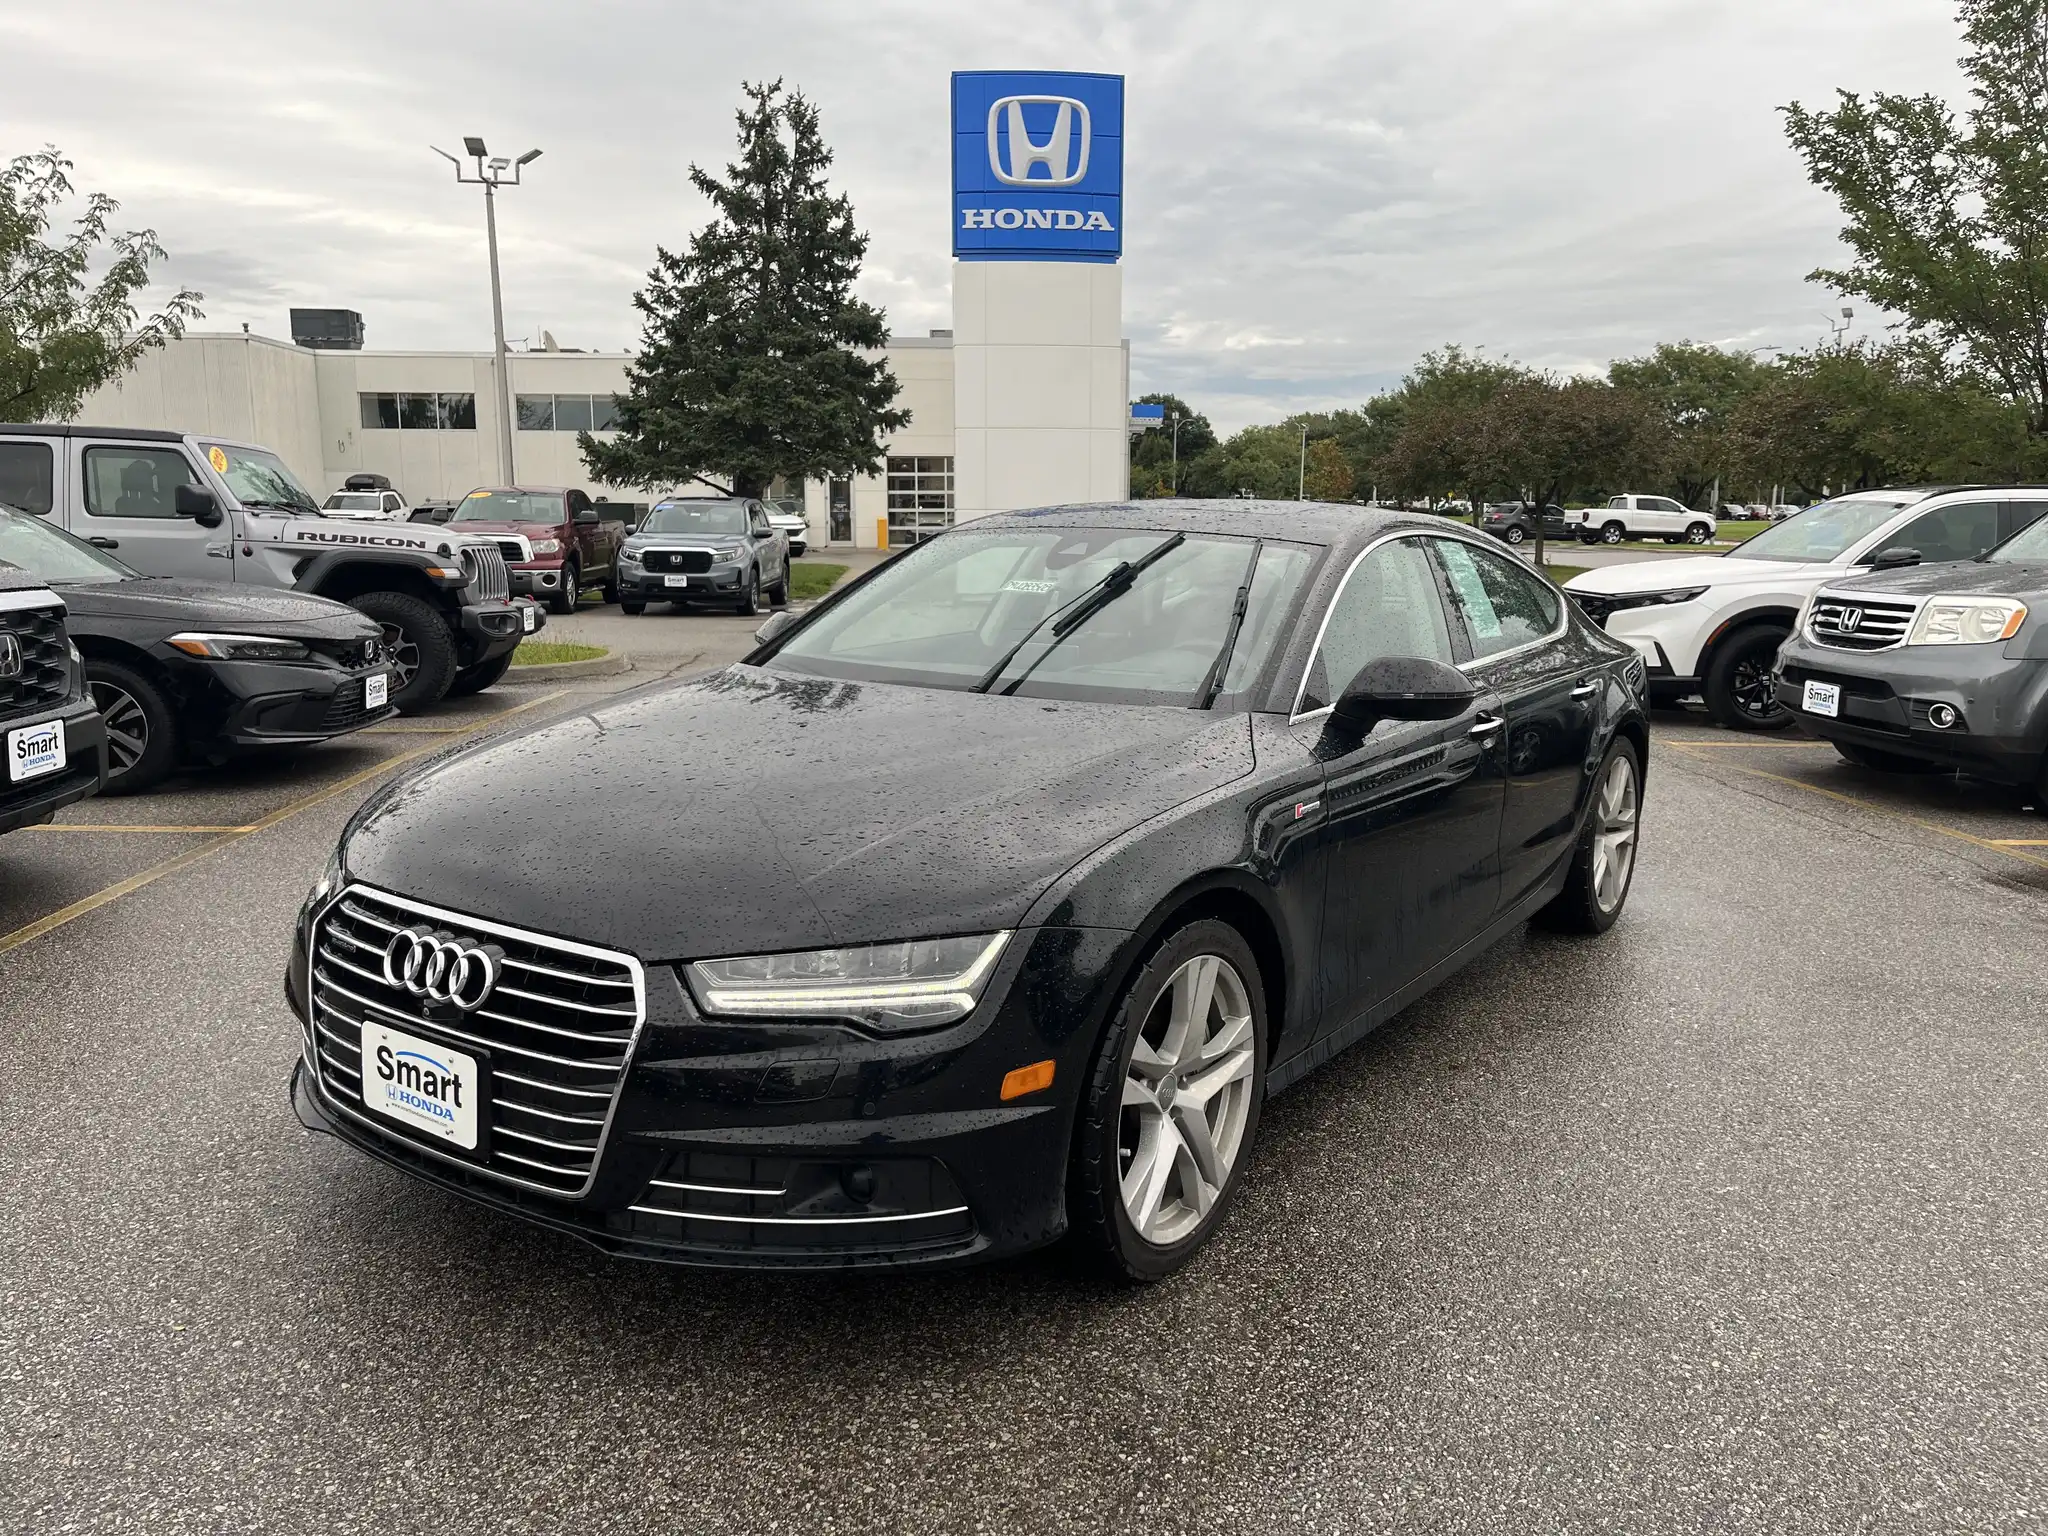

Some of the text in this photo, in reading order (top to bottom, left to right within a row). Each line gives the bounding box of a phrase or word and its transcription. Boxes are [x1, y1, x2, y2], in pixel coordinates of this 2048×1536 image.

[962, 208, 1115, 232] HONDA
[297, 531, 426, 549] RUBICON
[1808, 687, 1834, 704] Smart
[17, 732, 59, 760] Smart
[29, 753, 57, 766] HONDA
[376, 1044, 463, 1109] Smart
[399, 1090, 456, 1123] HONDA
